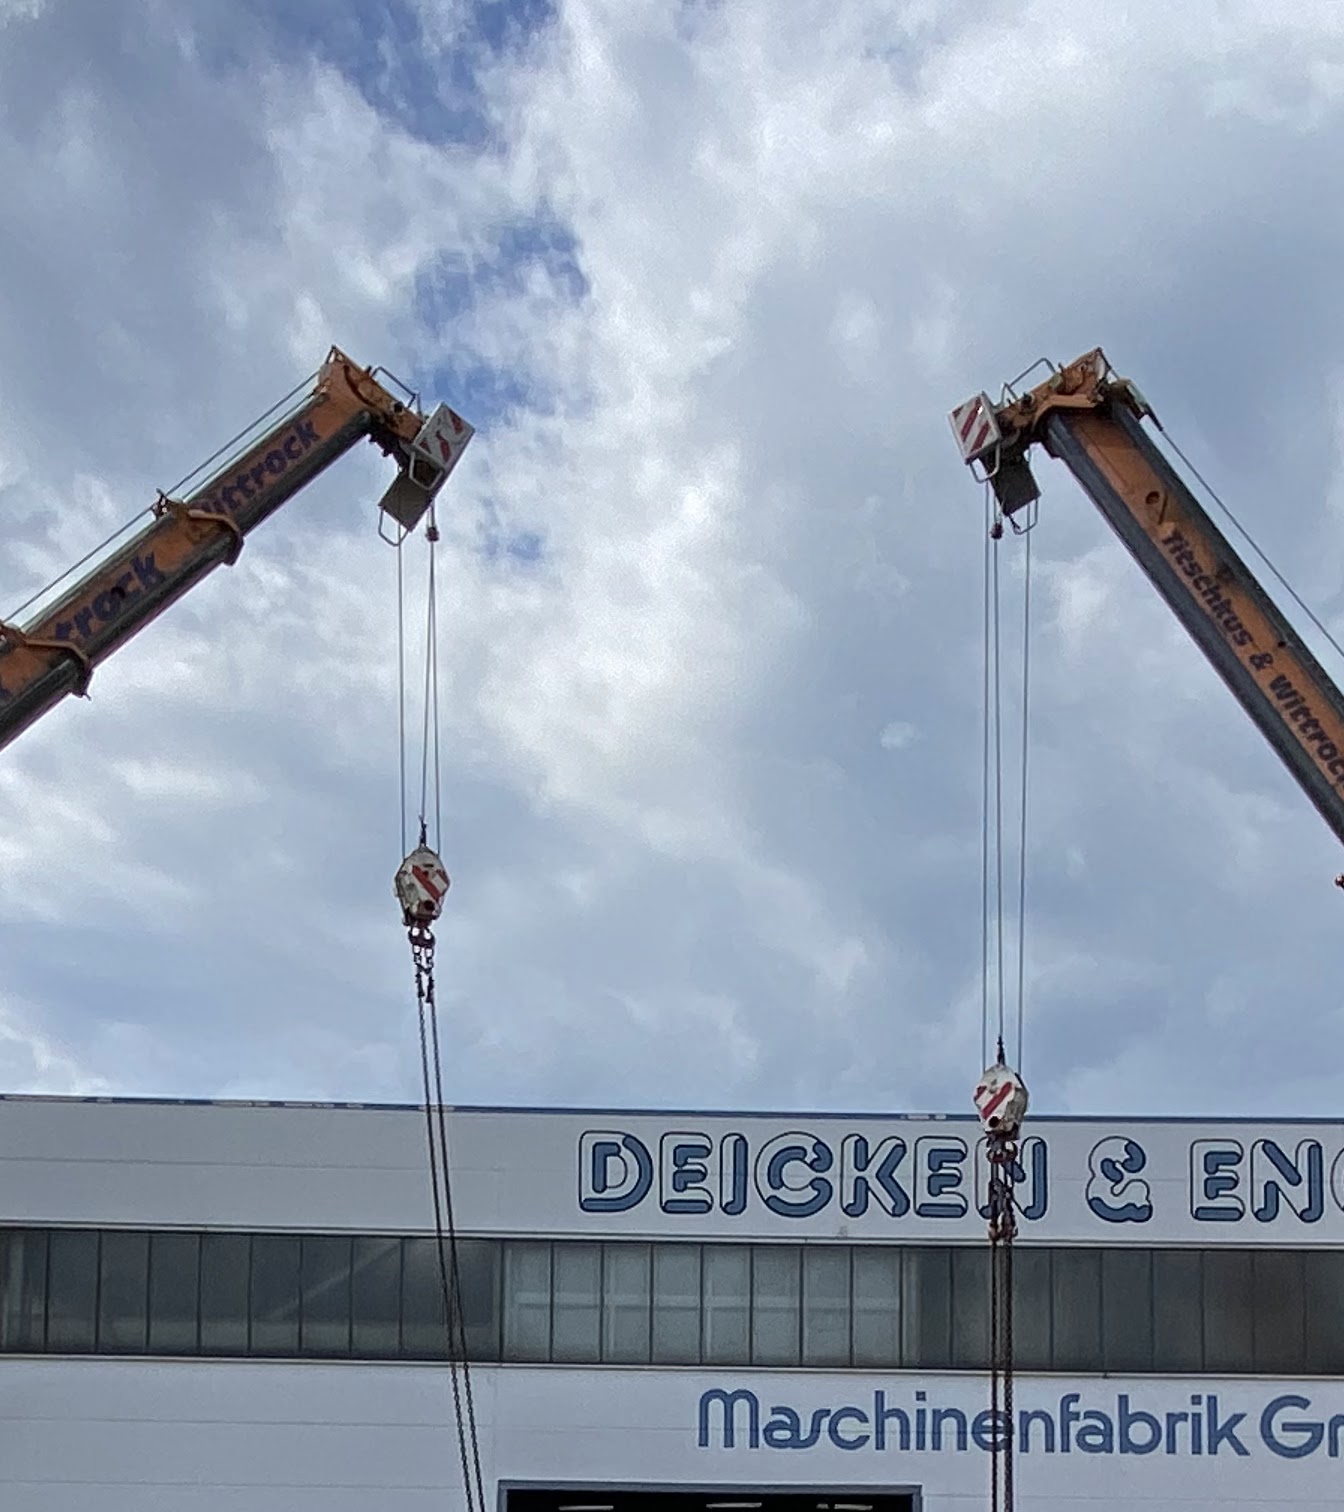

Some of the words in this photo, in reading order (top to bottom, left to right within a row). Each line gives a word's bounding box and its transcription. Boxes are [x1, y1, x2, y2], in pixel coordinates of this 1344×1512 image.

[1249, 652, 1274, 671] &
[579, 1130, 1049, 1220] DEICKEN
[1086, 1136, 1153, 1223] &
[698, 1388, 1251, 1456] Maschinenfabrik
